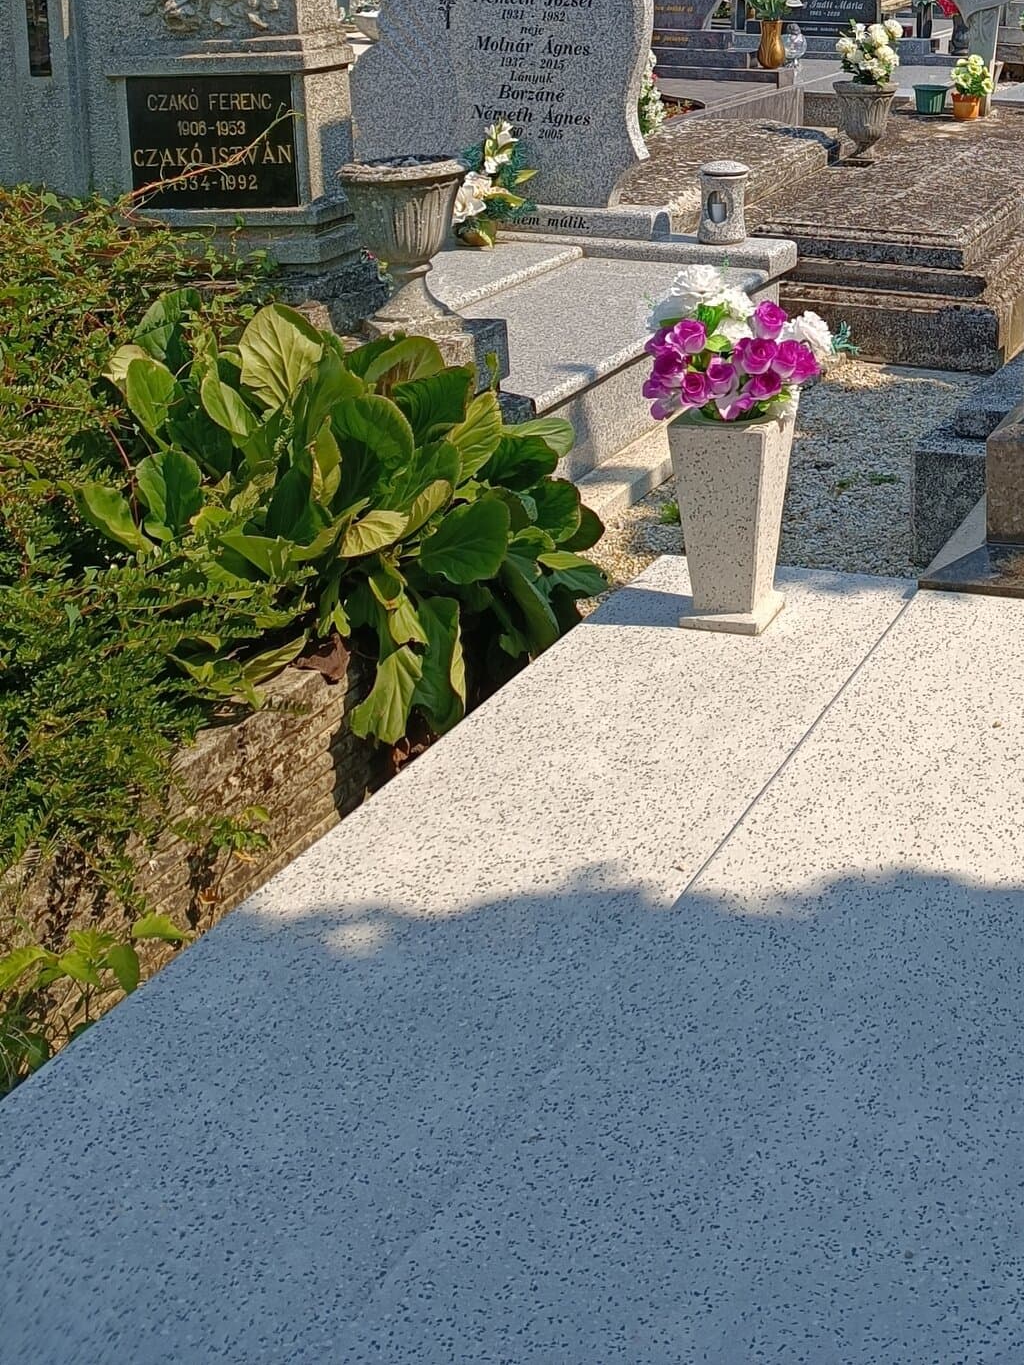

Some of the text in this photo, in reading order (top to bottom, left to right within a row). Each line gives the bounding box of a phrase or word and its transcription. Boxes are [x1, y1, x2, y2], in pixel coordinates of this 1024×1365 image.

[501, 9, 524, 20] 1931
[541, 11, 566, 22] 1982
[474, 35, 592, 57] Molnár Ágnes
[540, 59, 565, 70] 2015
[147, 88, 272, 111] CZAKÓ FERENC
[498, 84, 565, 102] Borzáné
[471, 104, 592, 126] Németh Ágnes
[177, 120, 246, 136] 1906-1953
[538, 129, 563, 139] 2005
[133, 141, 293, 167] CZAKÓ ISTVÁN
[548, 215, 590, 229] múlik.
